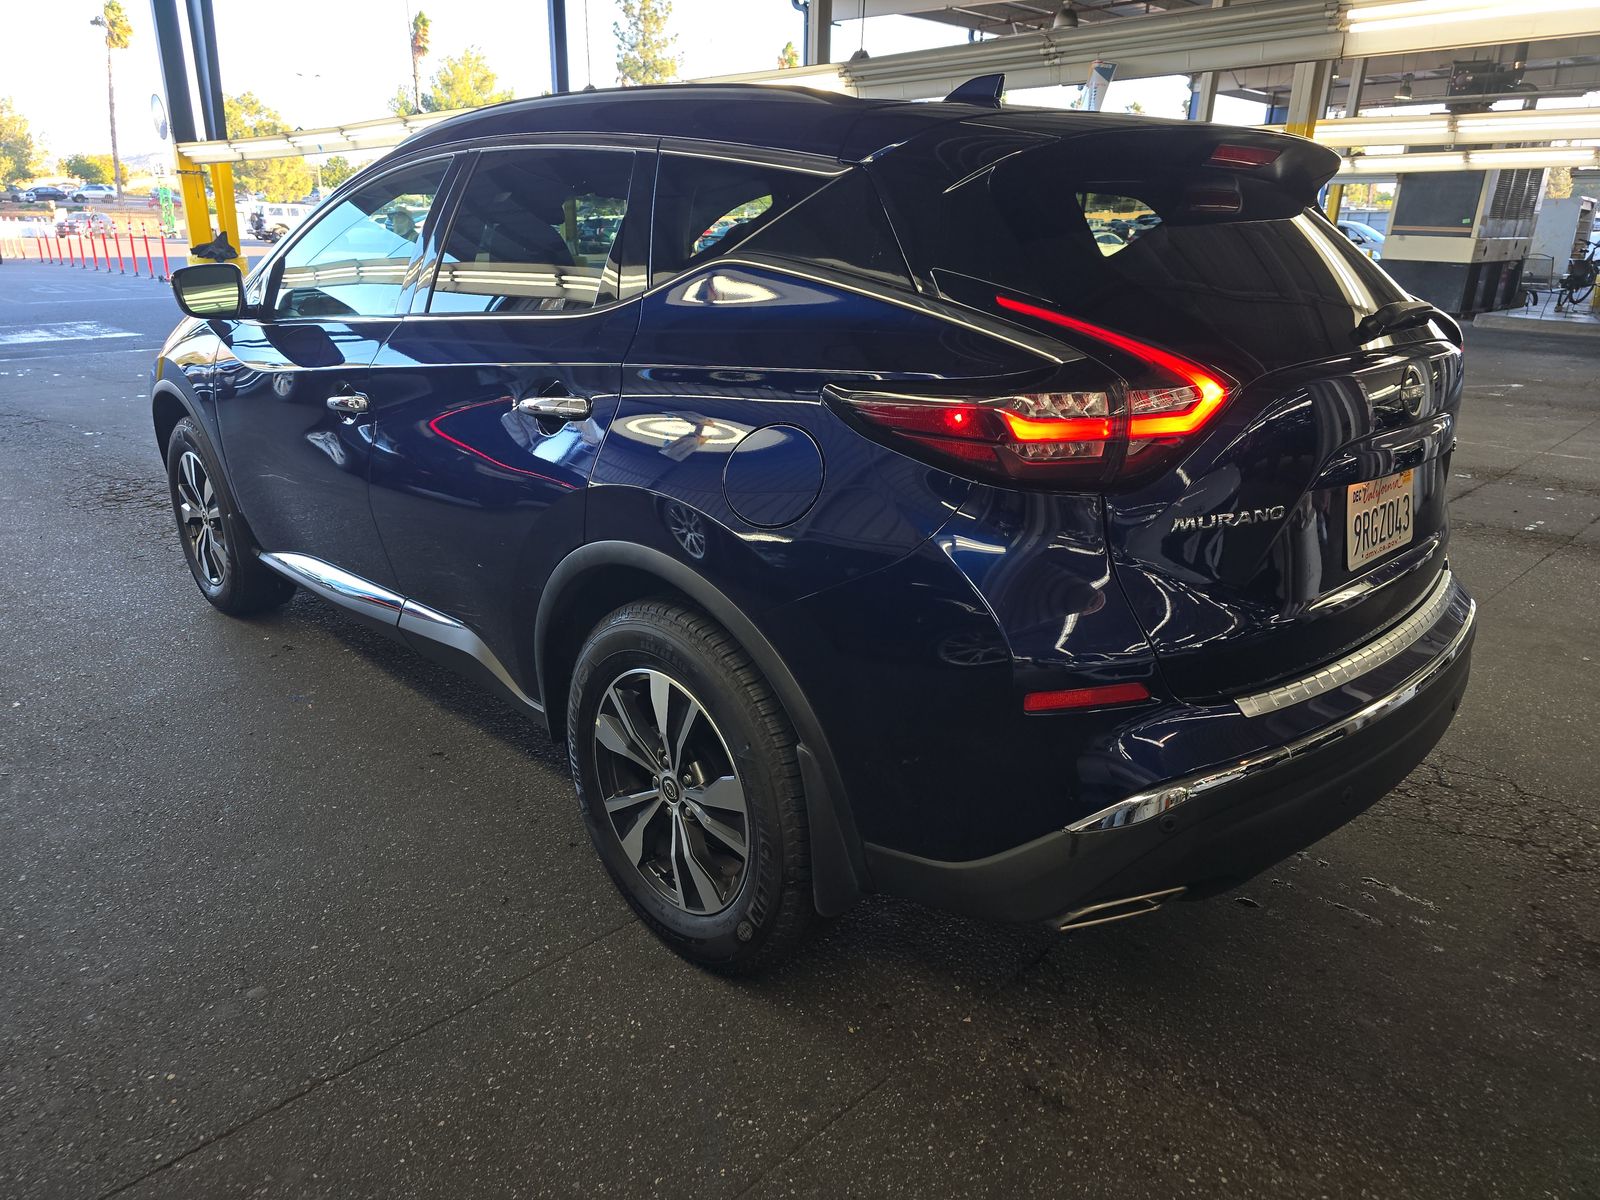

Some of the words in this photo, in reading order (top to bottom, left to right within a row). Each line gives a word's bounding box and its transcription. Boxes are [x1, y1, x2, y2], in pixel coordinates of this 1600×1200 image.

[1353, 489, 1362, 503] DEC
[1362, 478, 1403, 504] California
[1170, 505, 1285, 533] MURANO
[1353, 494, 1410, 557] 9RGZ043
